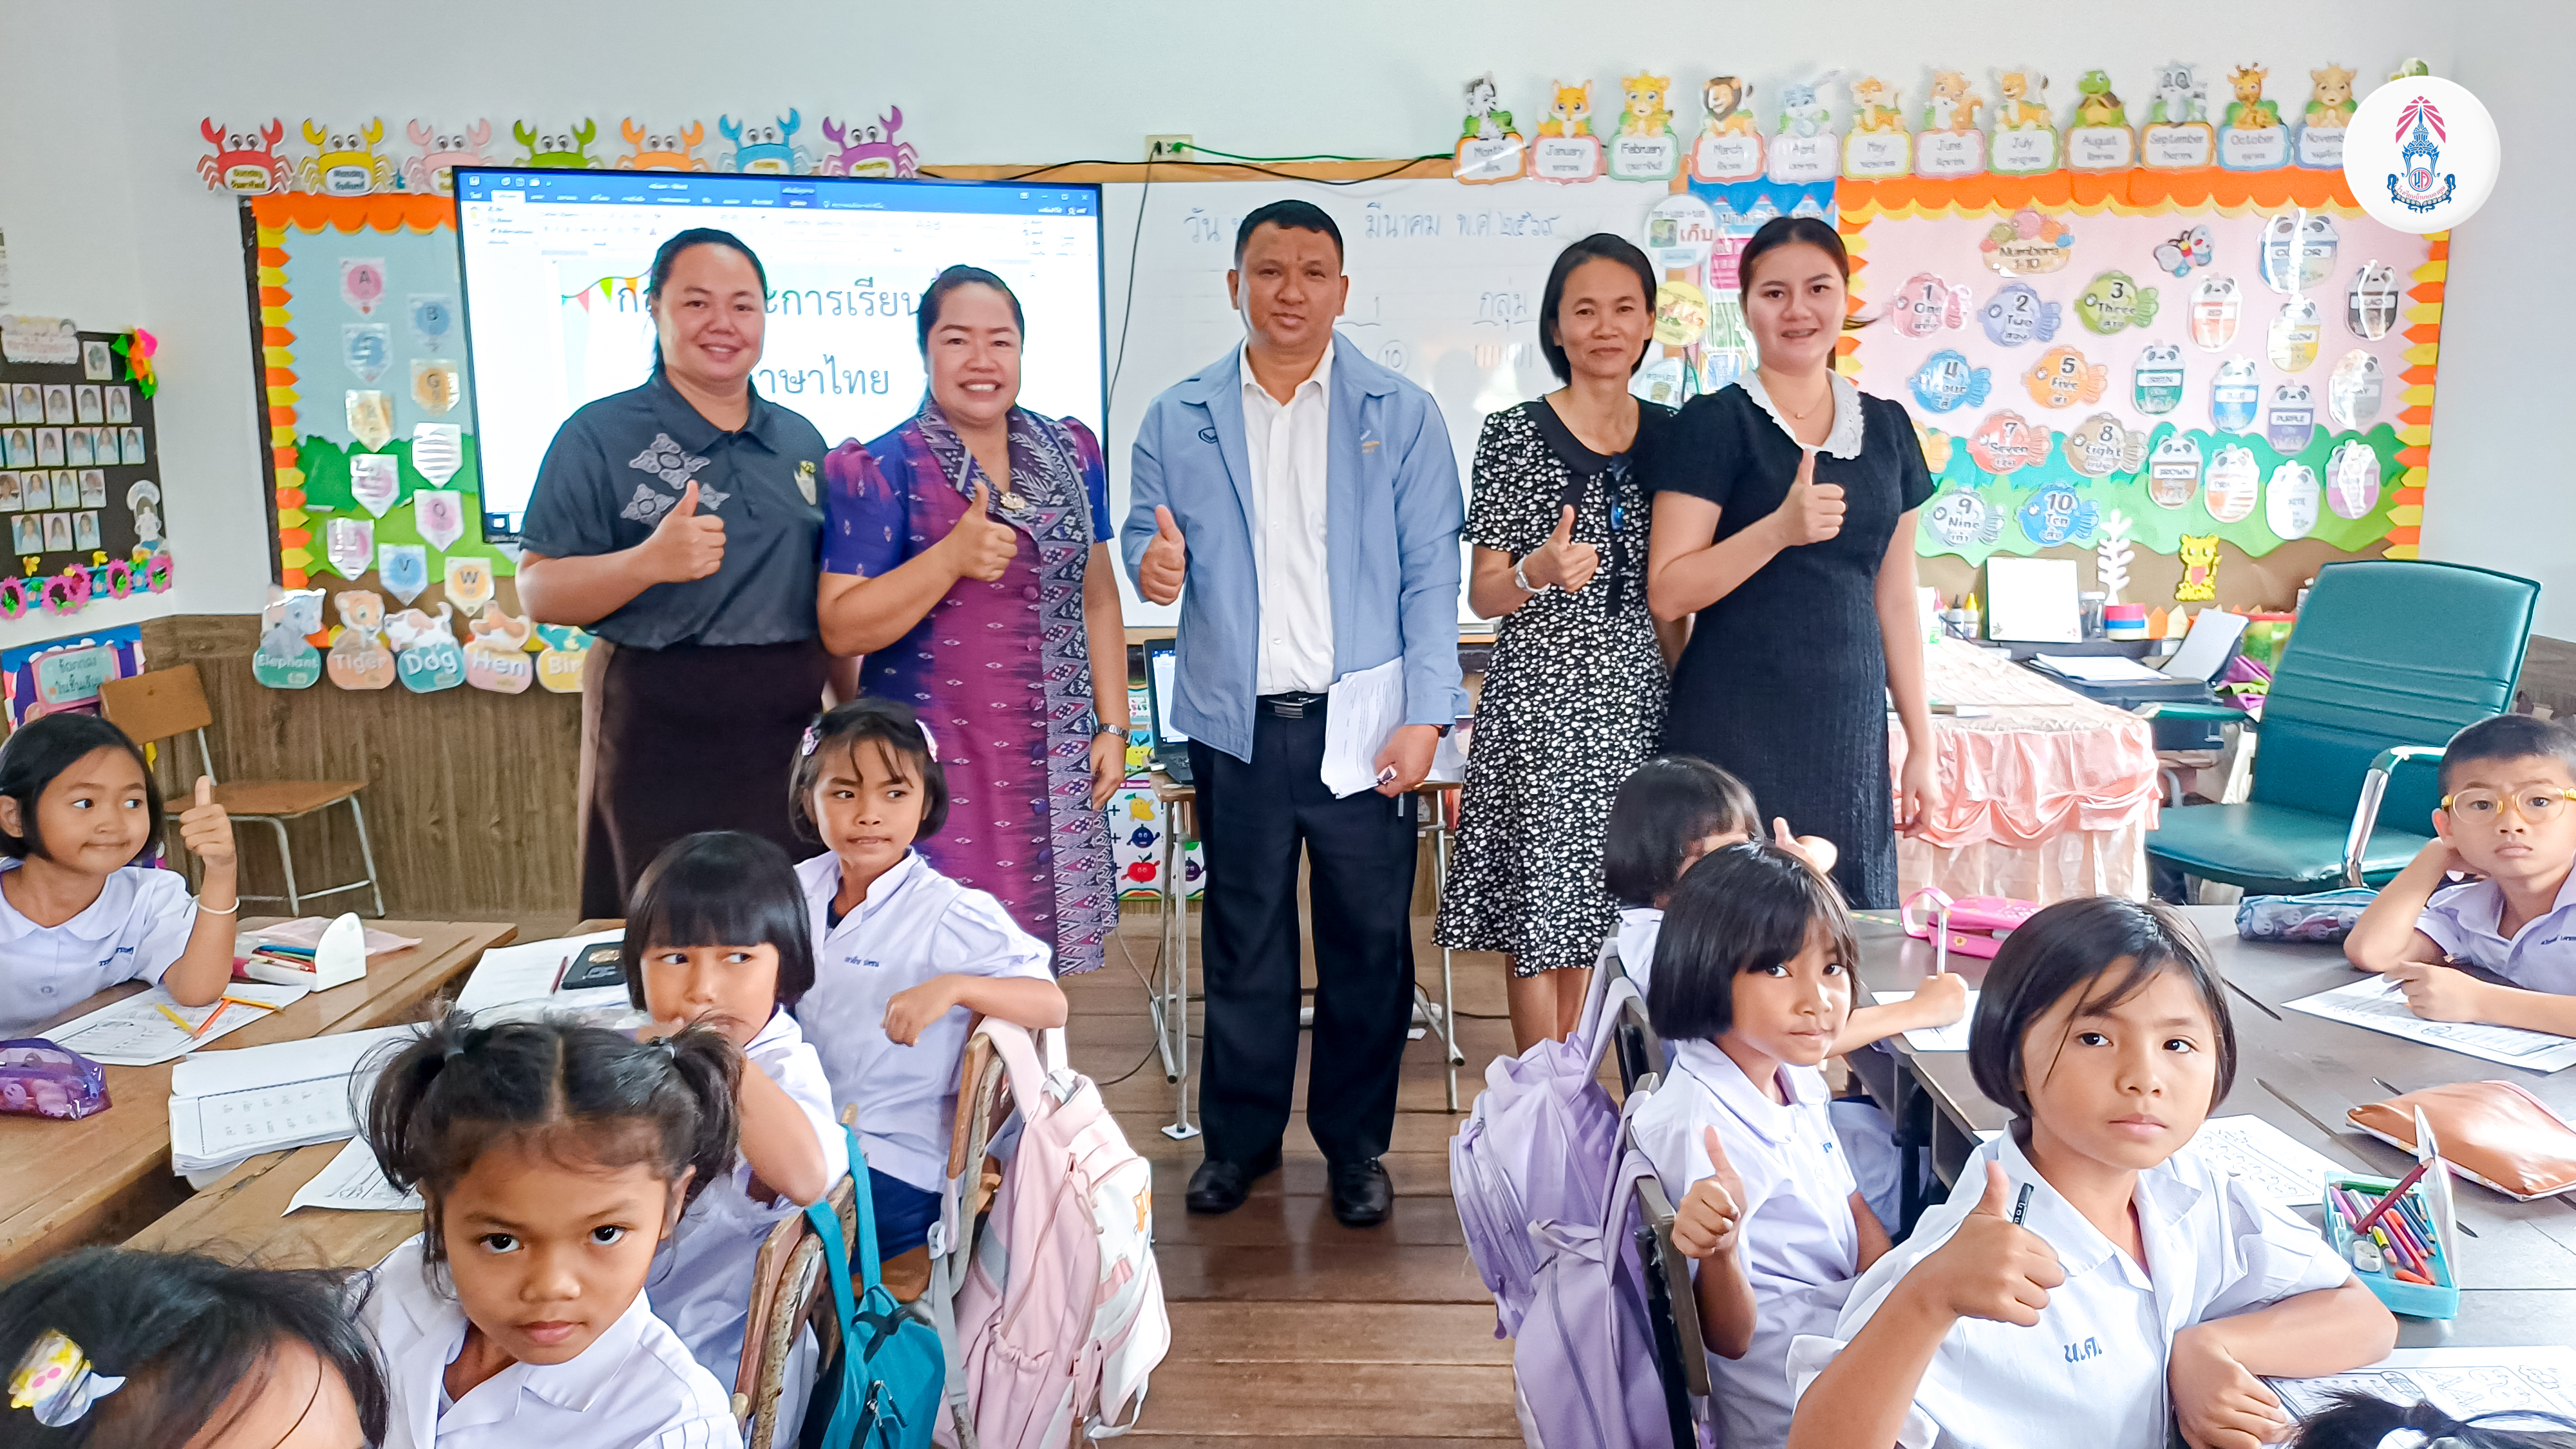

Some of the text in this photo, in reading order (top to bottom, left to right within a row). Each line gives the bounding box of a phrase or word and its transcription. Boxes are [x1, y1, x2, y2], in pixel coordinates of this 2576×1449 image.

[2230, 133, 2275, 146] October
[2306, 131, 2344, 144] Novemb
[1620, 142, 1666, 156] February
[1365, 202, 1442, 239] มีนาคม
[2111, 282, 2123, 298] 3
[2016, 295, 2028, 312] 2
[2098, 303, 2136, 314] Three
[2061, 357, 2076, 374] 5
[759, 354, 889, 395] าษาไทย
[2100, 426, 2113, 441] 8
[1958, 498, 1972, 514] 9
[2048, 493, 2072, 511] 10
[1948, 516, 1980, 529] Nine
[2047, 513, 2069, 526] Ten
[398, 557, 410, 572] V
[256, 654, 319, 670] Elephant
[333, 650, 387, 674] Tiger
[403, 650, 459, 676] Dog
[472, 649, 532, 676] Hen
[548, 656, 584, 675] Bir
